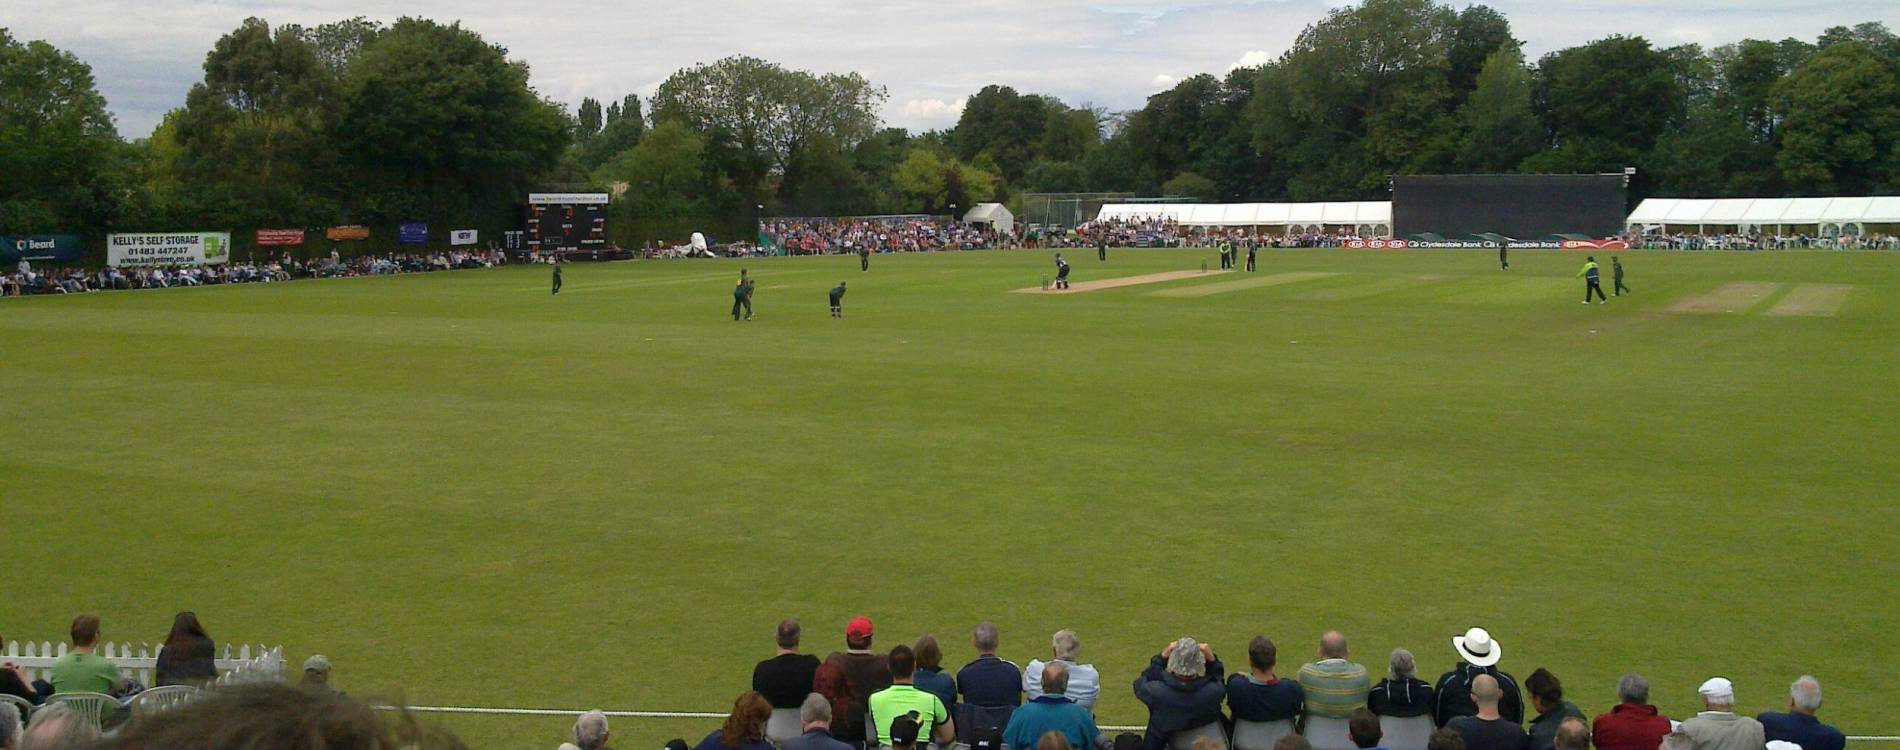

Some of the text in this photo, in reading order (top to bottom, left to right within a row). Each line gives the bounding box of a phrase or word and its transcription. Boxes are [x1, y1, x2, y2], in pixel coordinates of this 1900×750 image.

[29, 238, 55, 249] Beard
[113, 235, 199, 246] KELLY'S SELF STORAGE
[128, 247, 188, 255] 01483 447247
